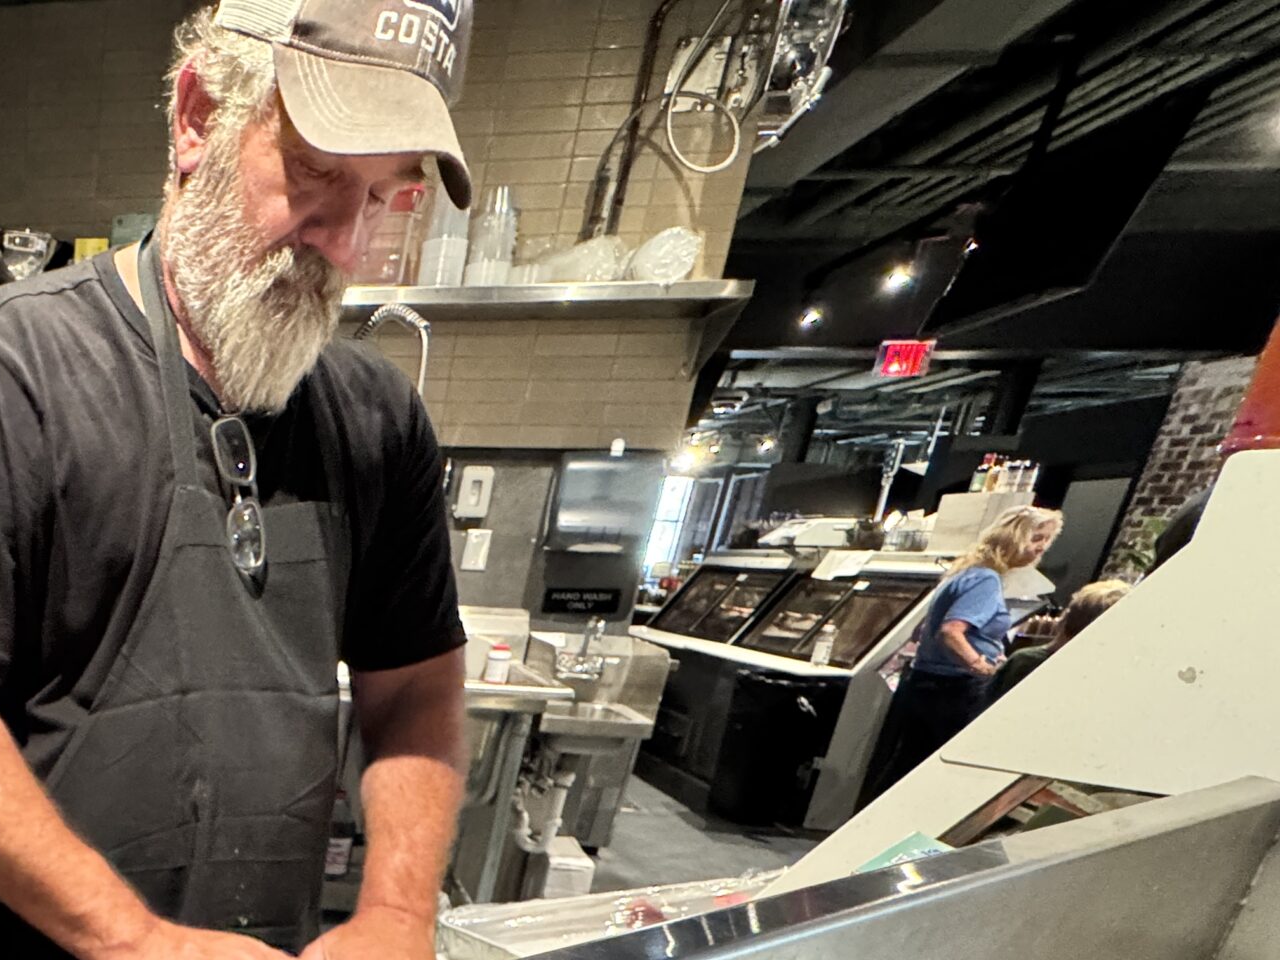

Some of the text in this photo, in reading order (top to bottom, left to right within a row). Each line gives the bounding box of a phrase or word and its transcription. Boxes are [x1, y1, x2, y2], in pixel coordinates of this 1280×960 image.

[374, 10, 458, 78] COSTA
[551, 591, 613, 601] HAND WASH
[566, 601, 594, 610] ONLY
